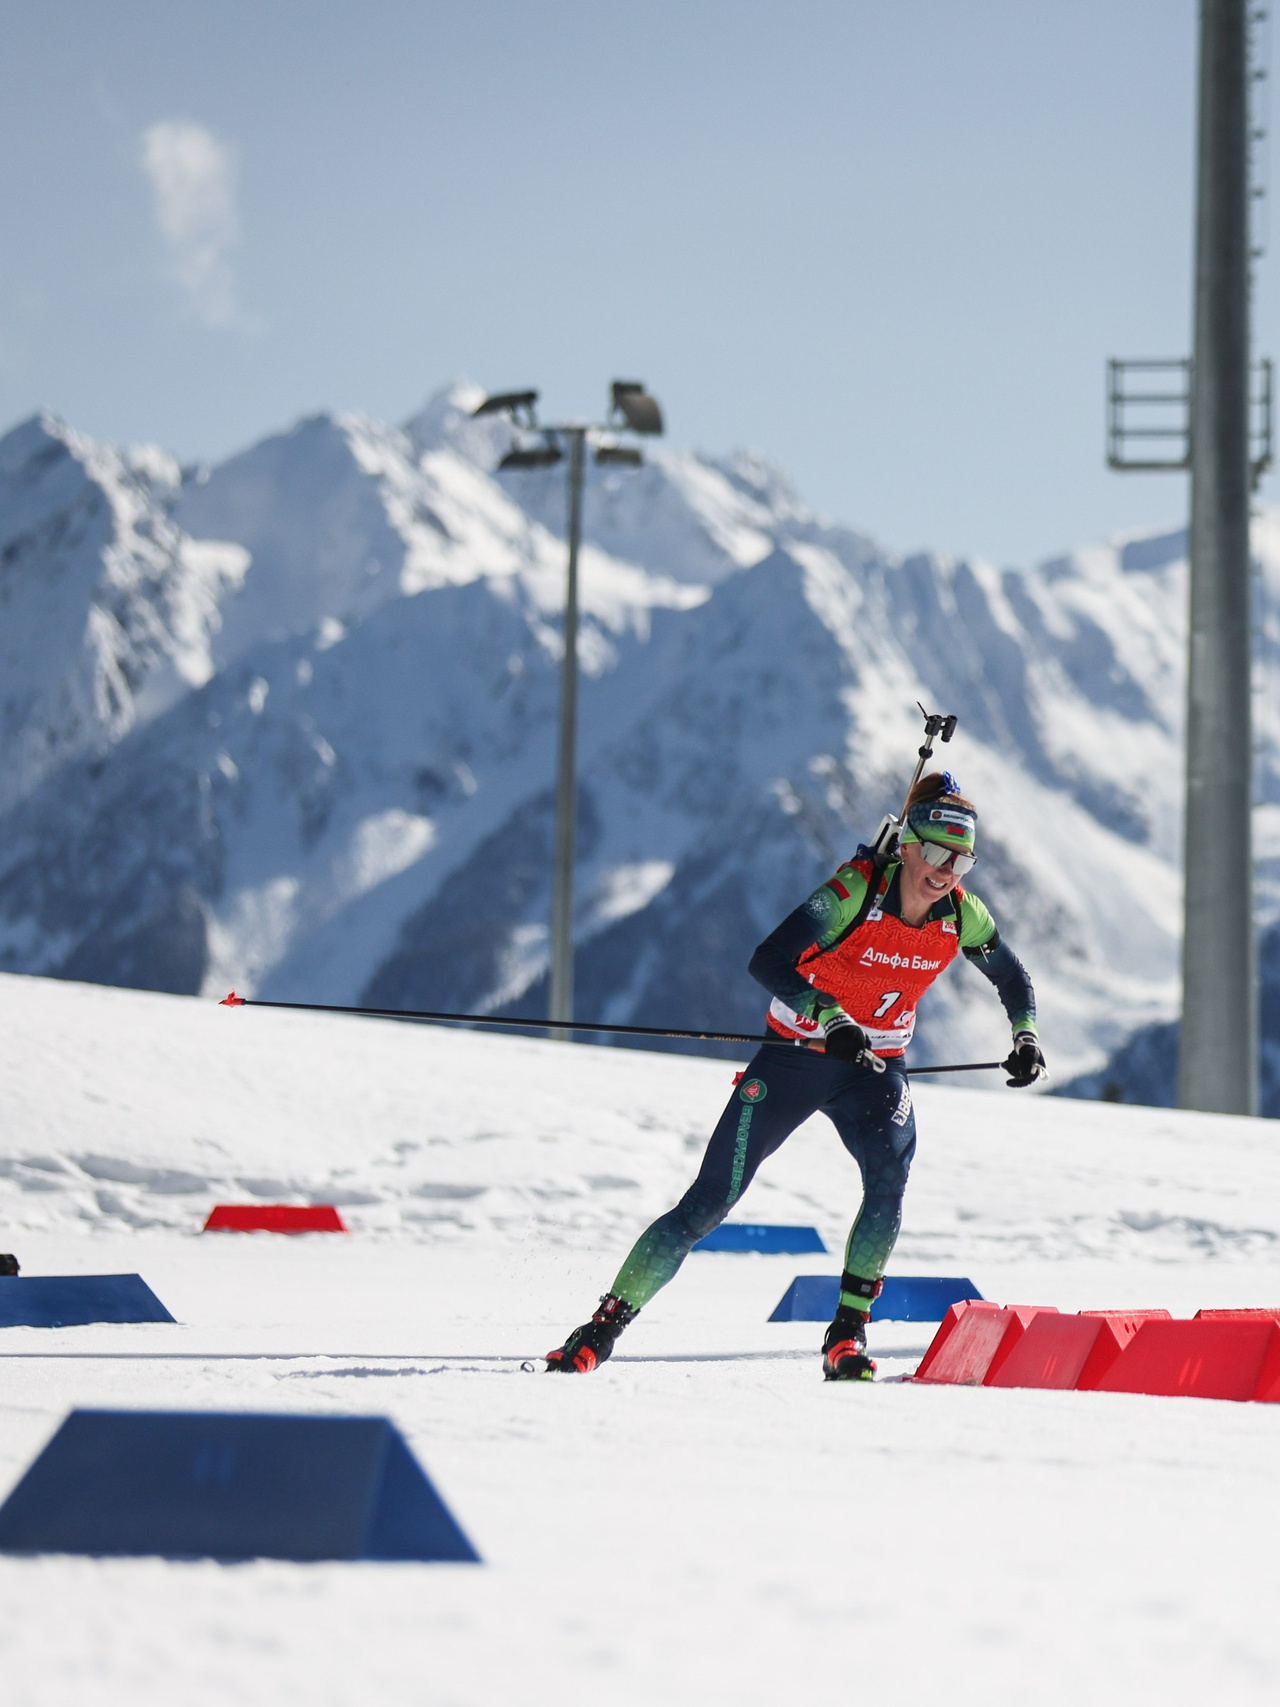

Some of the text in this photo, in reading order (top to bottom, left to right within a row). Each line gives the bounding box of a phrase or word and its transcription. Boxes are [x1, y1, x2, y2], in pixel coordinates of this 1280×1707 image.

[860, 946, 941, 970] Альфа Банк
[872, 990, 903, 1019] 1
[725, 1104, 753, 1204] БЕЛОРУСНЕФТЬ
